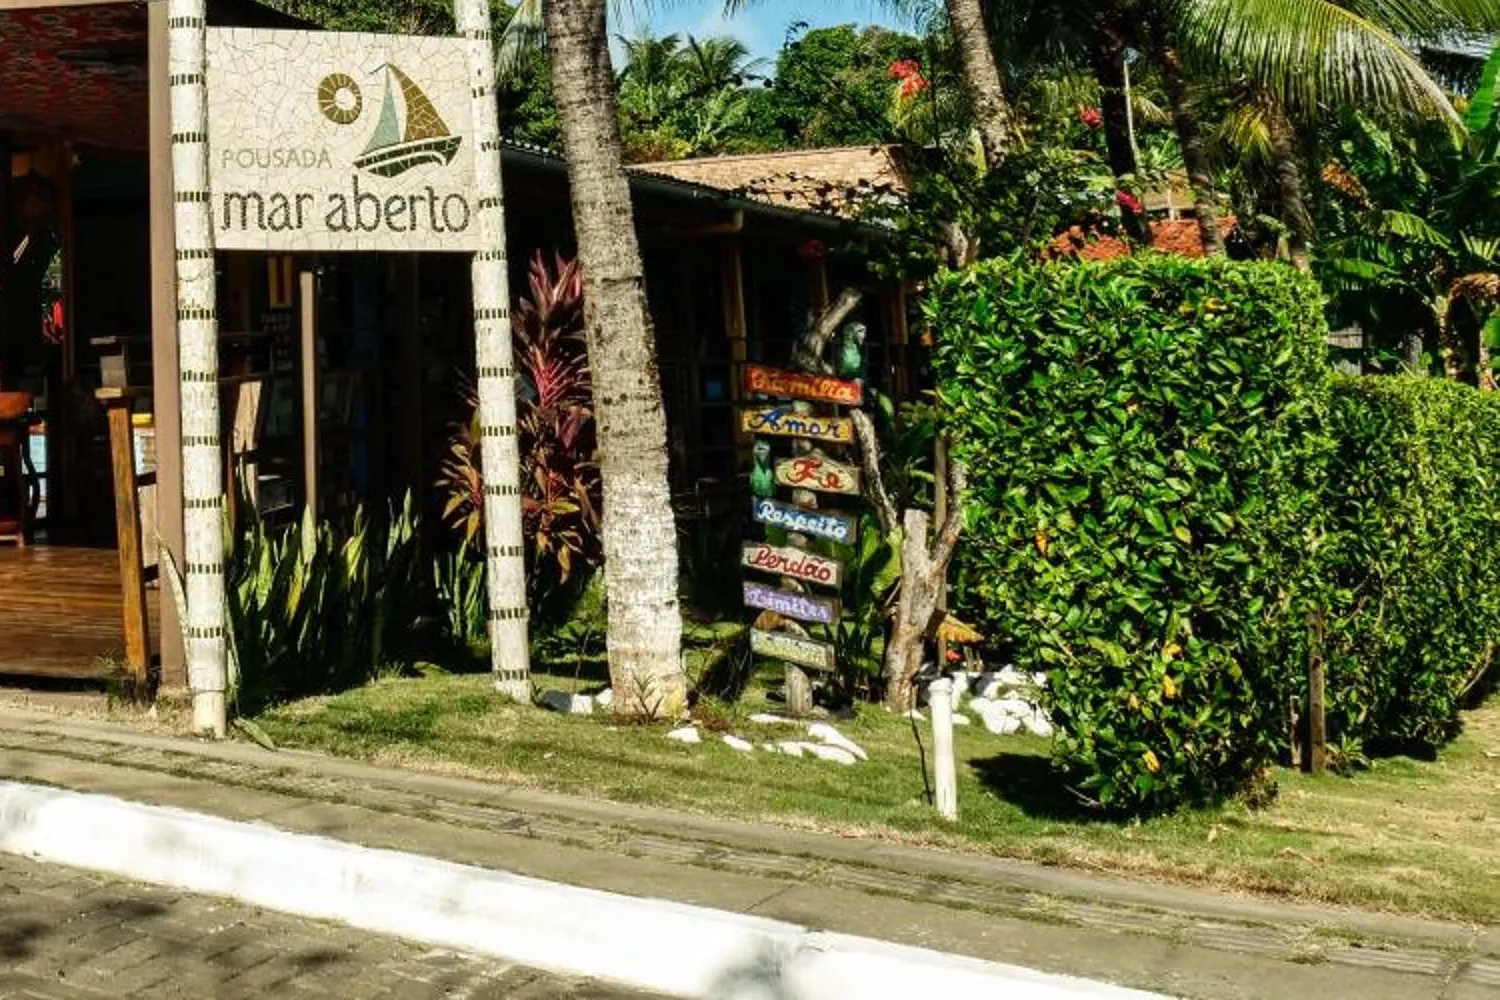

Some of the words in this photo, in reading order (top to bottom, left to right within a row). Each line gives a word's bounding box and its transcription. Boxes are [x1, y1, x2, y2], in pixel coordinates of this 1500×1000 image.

[221, 148, 333, 170] POUSADA
[220, 190, 315, 232] mar
[324, 173, 471, 233] aberto
[748, 404, 842, 438] Amor
[748, 544, 832, 581] Perdão
